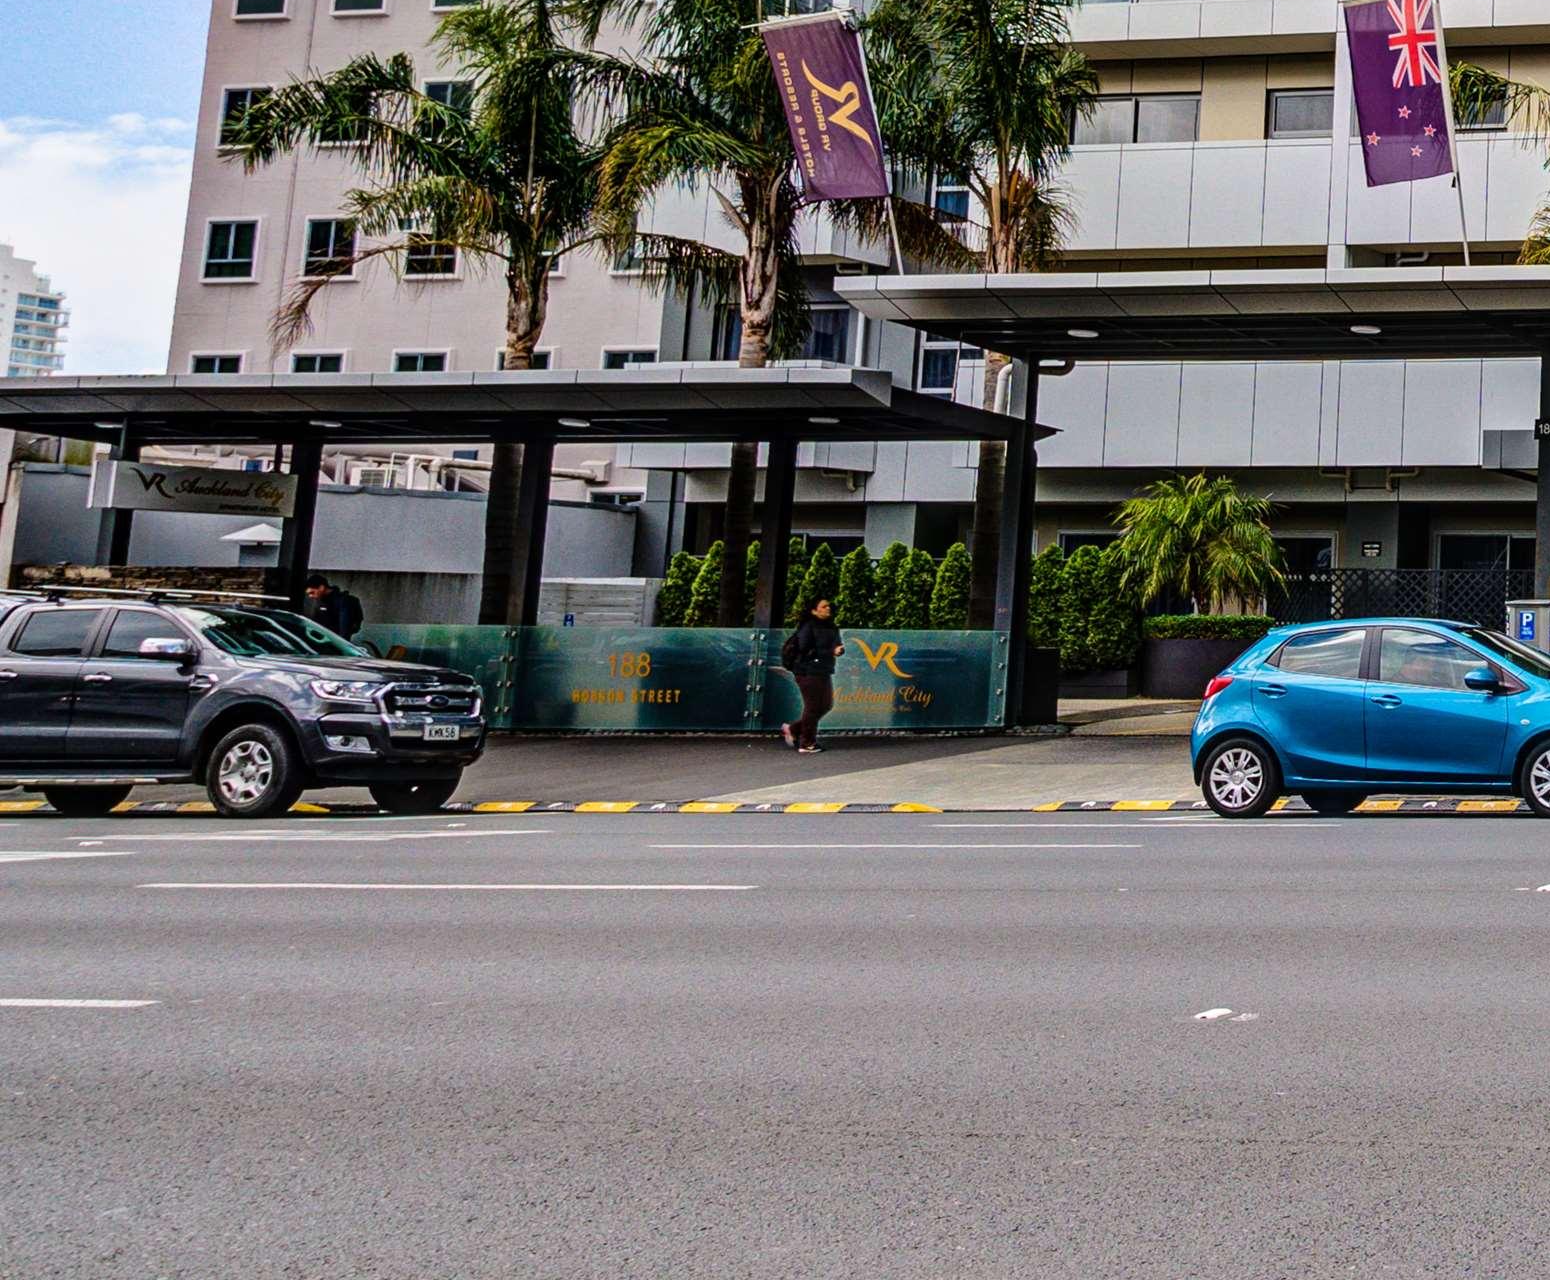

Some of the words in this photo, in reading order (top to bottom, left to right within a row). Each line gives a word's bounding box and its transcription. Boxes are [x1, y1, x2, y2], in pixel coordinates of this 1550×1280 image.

[175, 476, 251, 498] Auckland
[254, 480, 286, 505] City
[608, 650, 652, 678] 188
[631, 688, 681, 704] STREET
[898, 685, 933, 708] City
